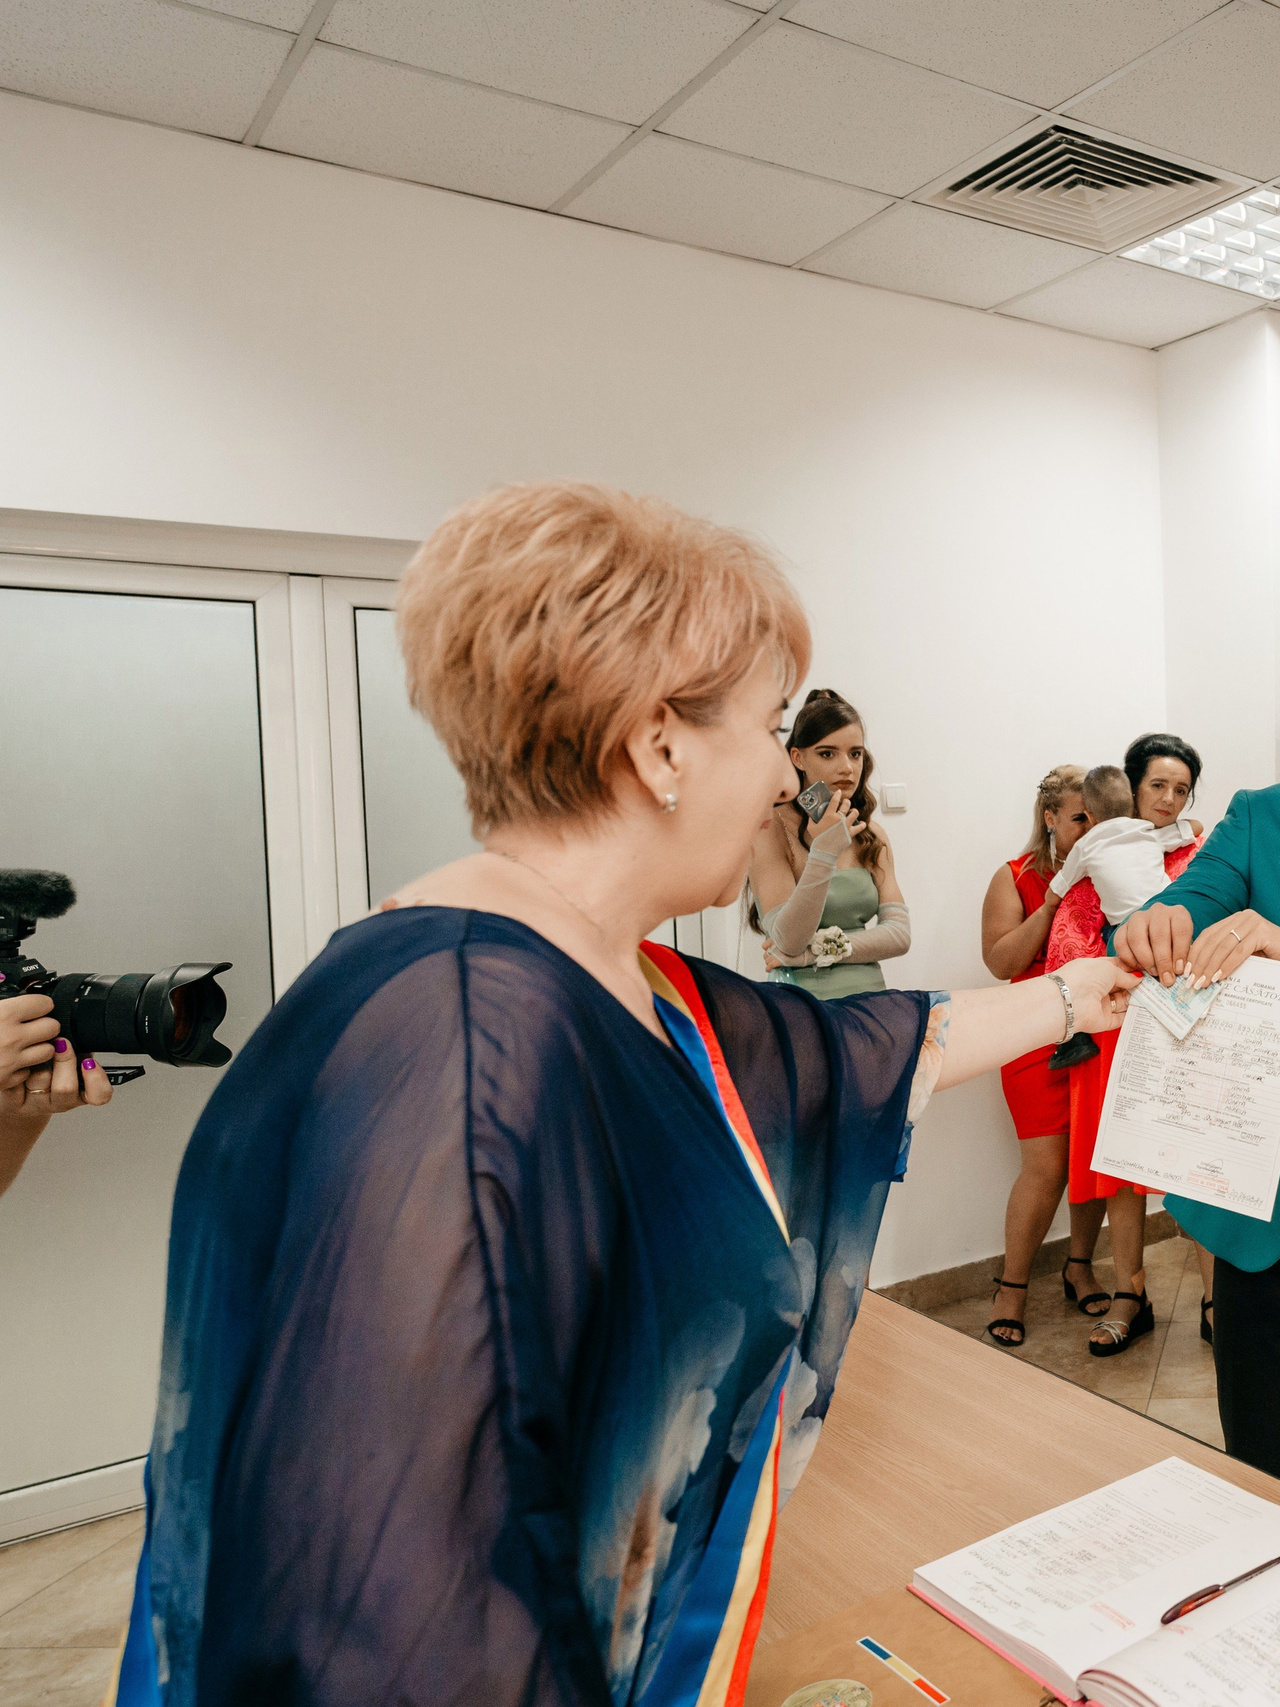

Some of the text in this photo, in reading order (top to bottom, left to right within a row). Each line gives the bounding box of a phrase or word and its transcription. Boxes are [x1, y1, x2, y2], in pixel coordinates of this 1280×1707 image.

[22, 963, 40, 973] SONY
[1253, 982, 1276, 991] ROMANIA
[1246, 997, 1273, 1007] CERTIFICATE
